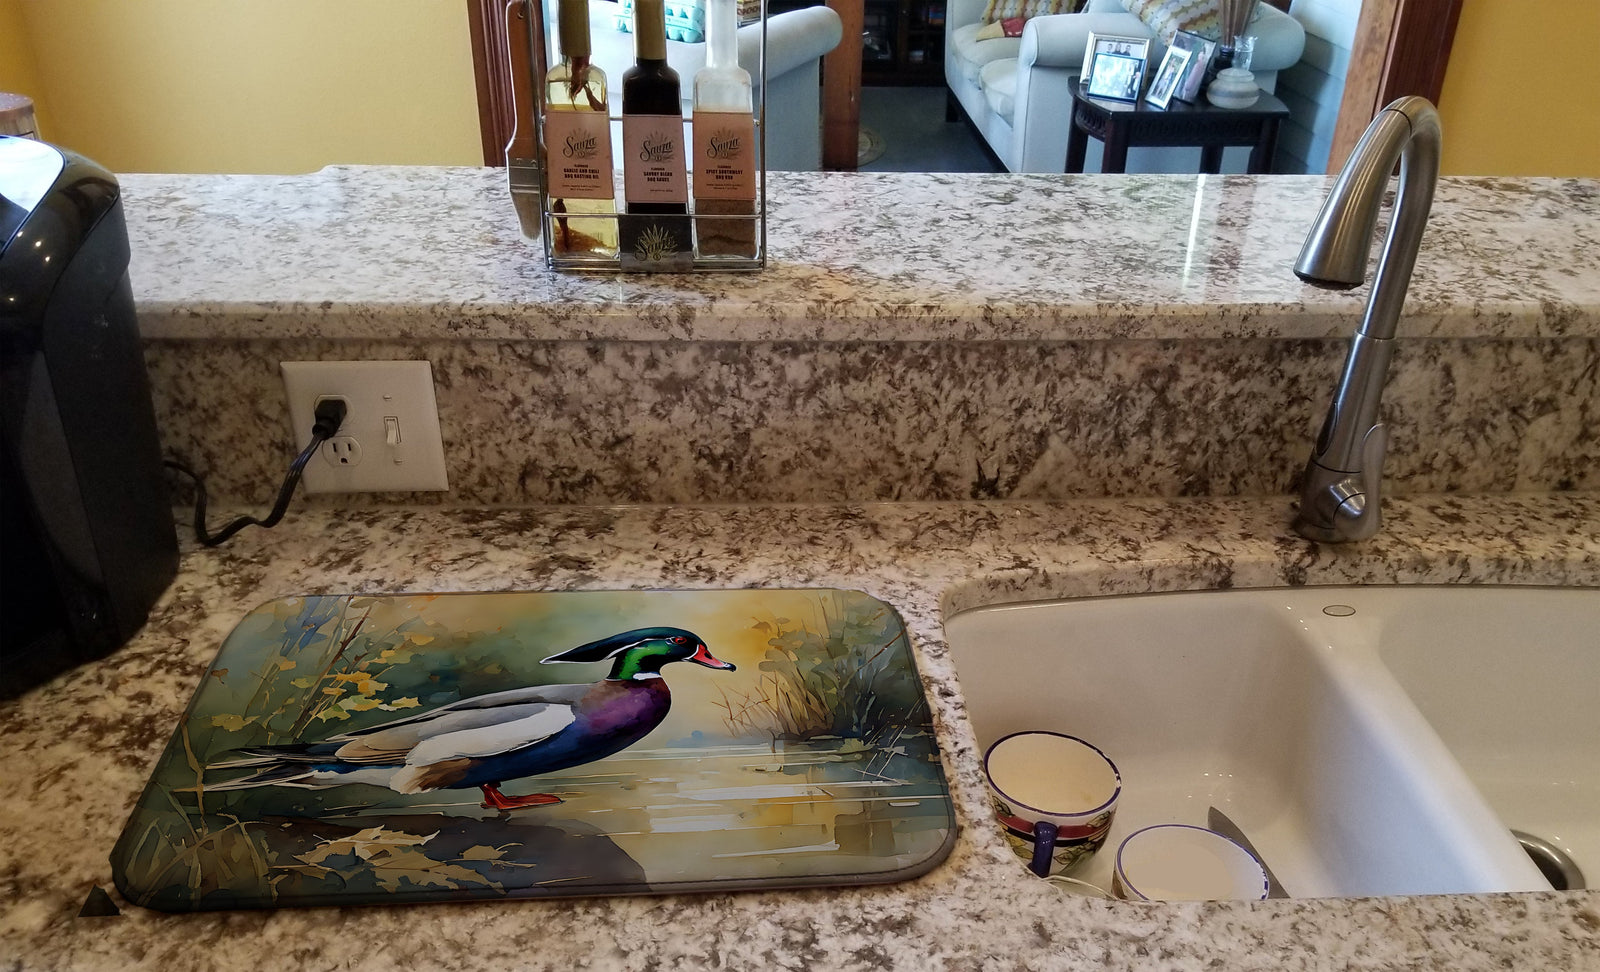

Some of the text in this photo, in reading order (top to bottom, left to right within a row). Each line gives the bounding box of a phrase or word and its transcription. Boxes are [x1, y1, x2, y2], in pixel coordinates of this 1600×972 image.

[562, 136, 598, 158] Sauza
[640, 140, 674, 162] Sauza
[706, 136, 740, 159] Sauza
